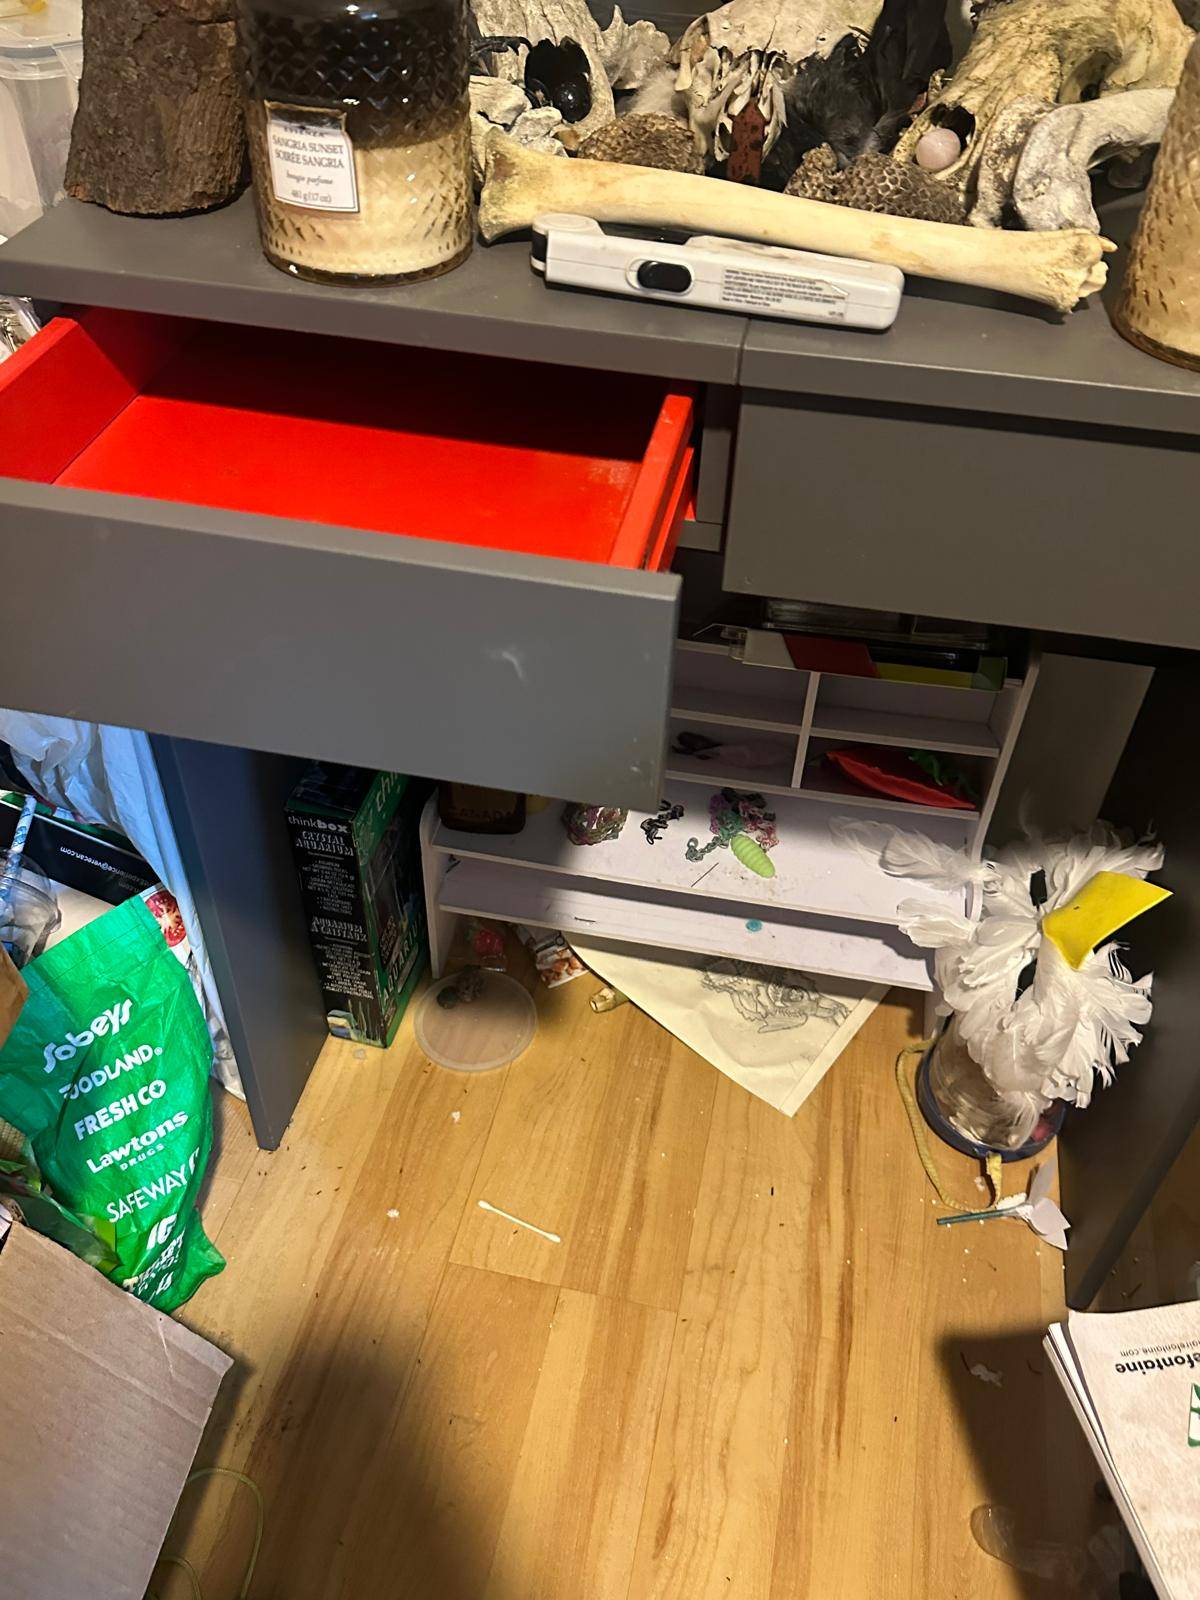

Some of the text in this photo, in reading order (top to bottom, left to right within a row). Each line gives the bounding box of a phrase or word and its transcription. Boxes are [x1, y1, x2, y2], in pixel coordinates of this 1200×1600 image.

[272, 134, 344, 154] SANGRIA SUNSET
[275, 148, 345, 169] SOIRÉE SANGRIA
[288, 816, 351, 833] thinkbox
[296, 839, 354, 856] AQUARIUM
[302, 831, 345, 846] CRYSTAL
[311, 916, 363, 933] AQUARIUM
[320, 927, 368, 942] CRISTAUX
[43, 998, 133, 1074] Sobeys
[86, 1111, 189, 1174] Lawtons
[119, 1143, 165, 1172] DRUGS
[106, 1163, 188, 1223] SAFEWAY
